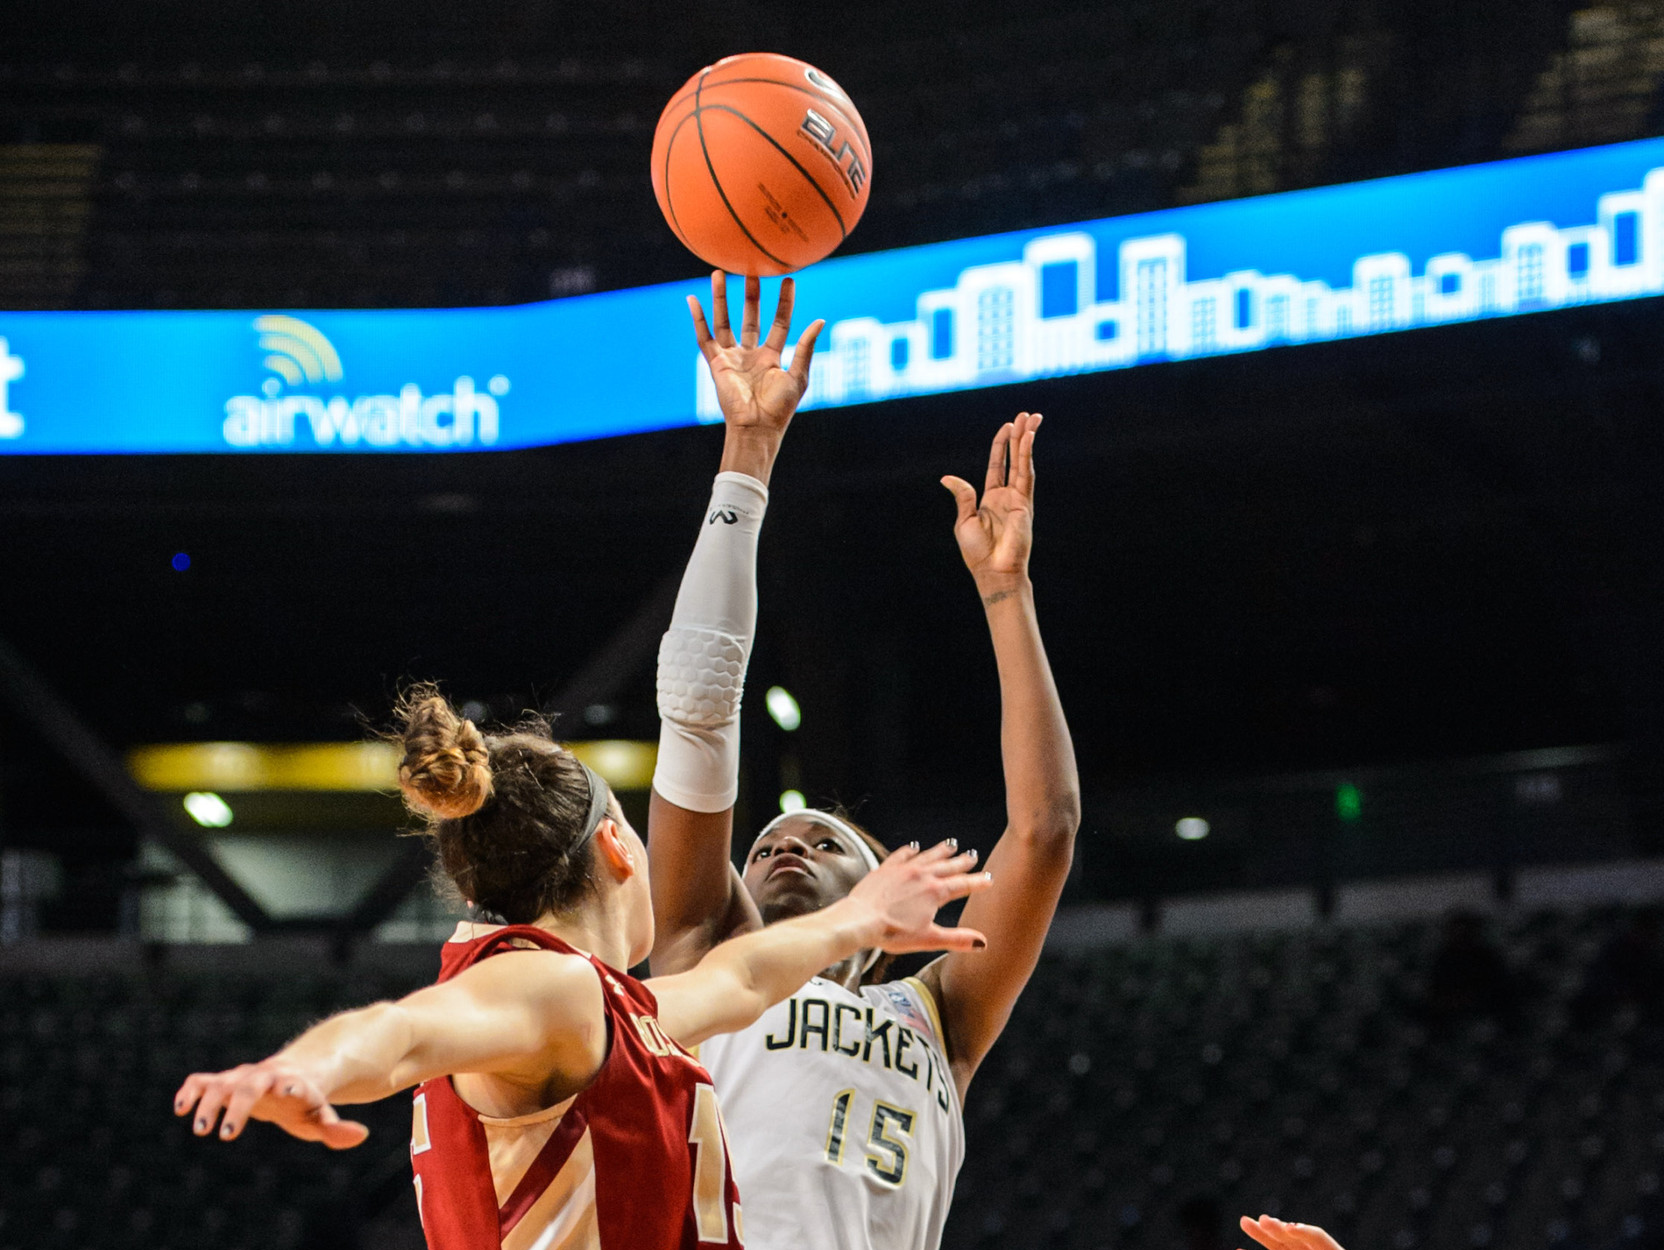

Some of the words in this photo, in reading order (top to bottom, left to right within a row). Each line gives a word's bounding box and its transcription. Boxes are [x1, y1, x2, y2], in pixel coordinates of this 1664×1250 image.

[801, 108, 866, 195] ELITE
[223, 375, 499, 447] airwatch
[688, 1081, 745, 1247] 1
[824, 1087, 918, 1188] 15
